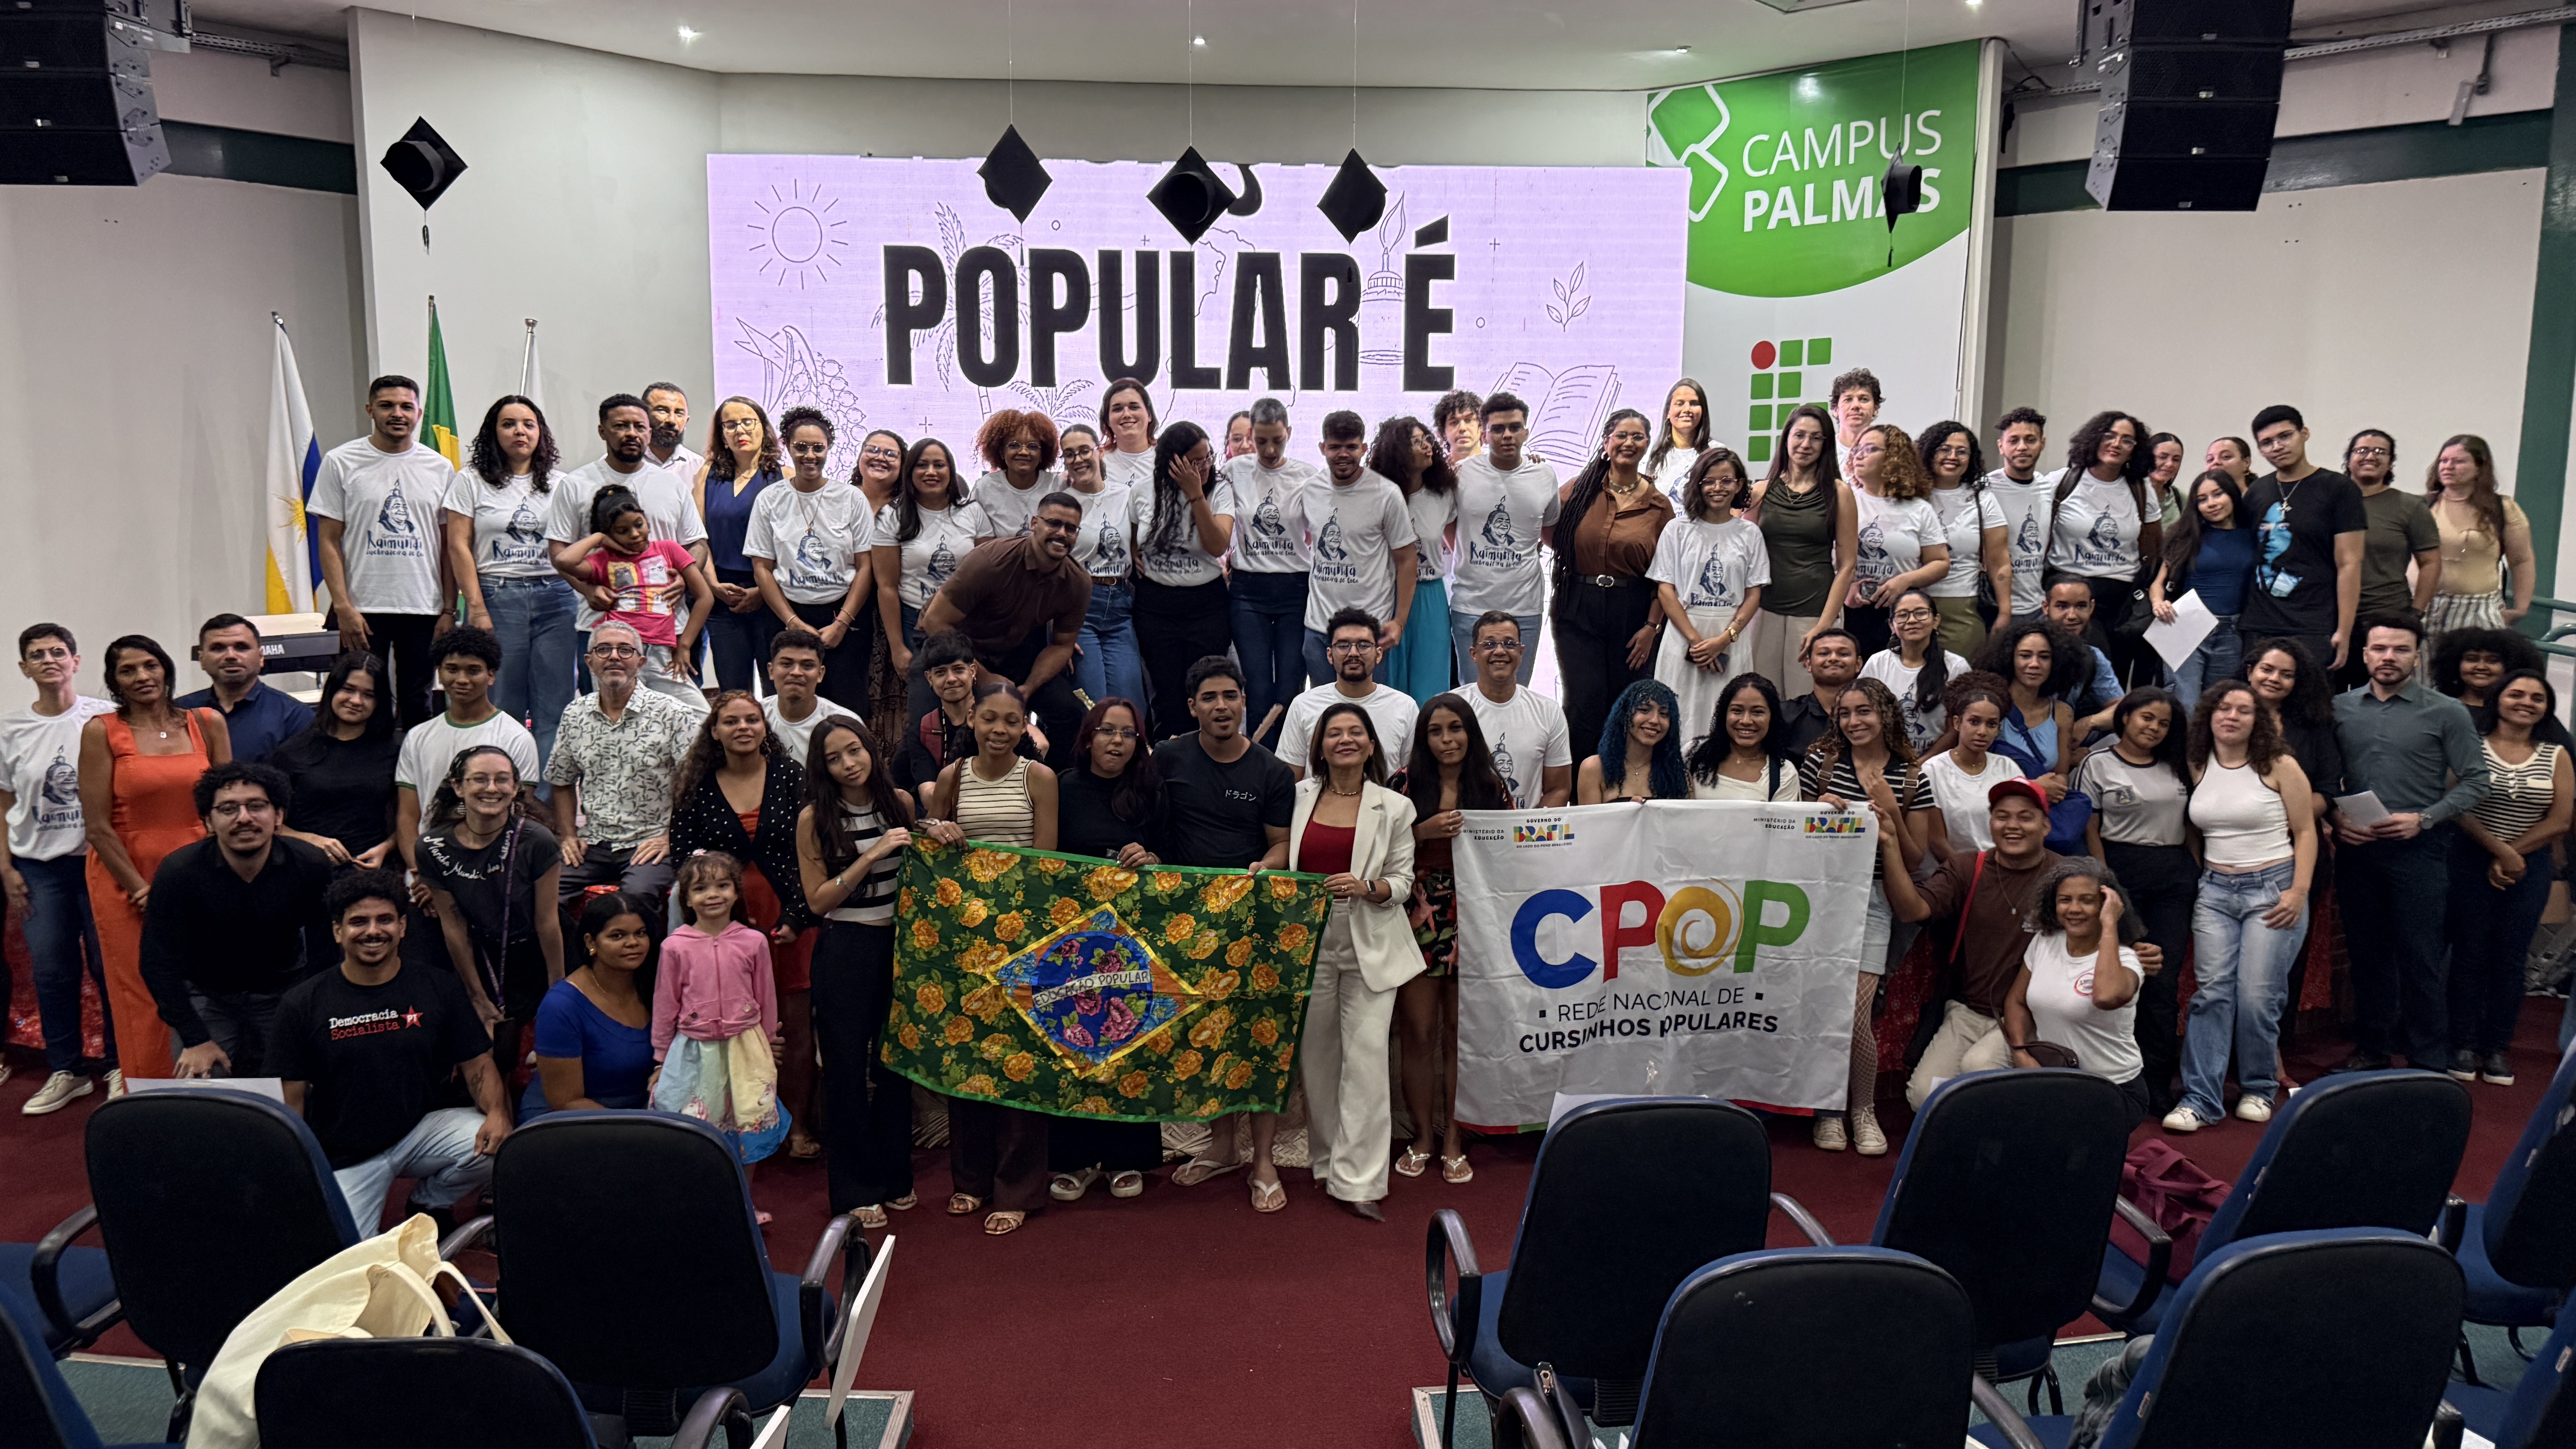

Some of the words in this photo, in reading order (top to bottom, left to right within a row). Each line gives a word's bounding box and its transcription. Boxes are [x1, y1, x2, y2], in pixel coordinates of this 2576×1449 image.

[1743, 110, 1941, 177] CAMPUS
[1743, 168, 1941, 232] PALMS
[883, 245, 1361, 391] POPULAR
[1403, 214, 1455, 391] É
[1855, 564, 1893, 575] imunda
[259, 644, 285, 656] MAHA
[1513, 823, 1575, 842] BRASIL
[1805, 817, 1866, 833] BRASIL
[1510, 877, 1811, 989] CPOP
[1034, 977, 1094, 1006] EDUCAÇÃO
[1099, 971, 1149, 985] POPULAR
[328, 1008, 399, 1029] Democracia
[407, 1014, 419, 1023] PT
[1559, 995, 1606, 1022] REDE
[1614, 990, 1711, 1011] NACONAL
[1718, 987, 1745, 1004] DE
[331, 1021, 400, 1041] Socialista
[1519, 1017, 1651, 1053] CURSINHOS
